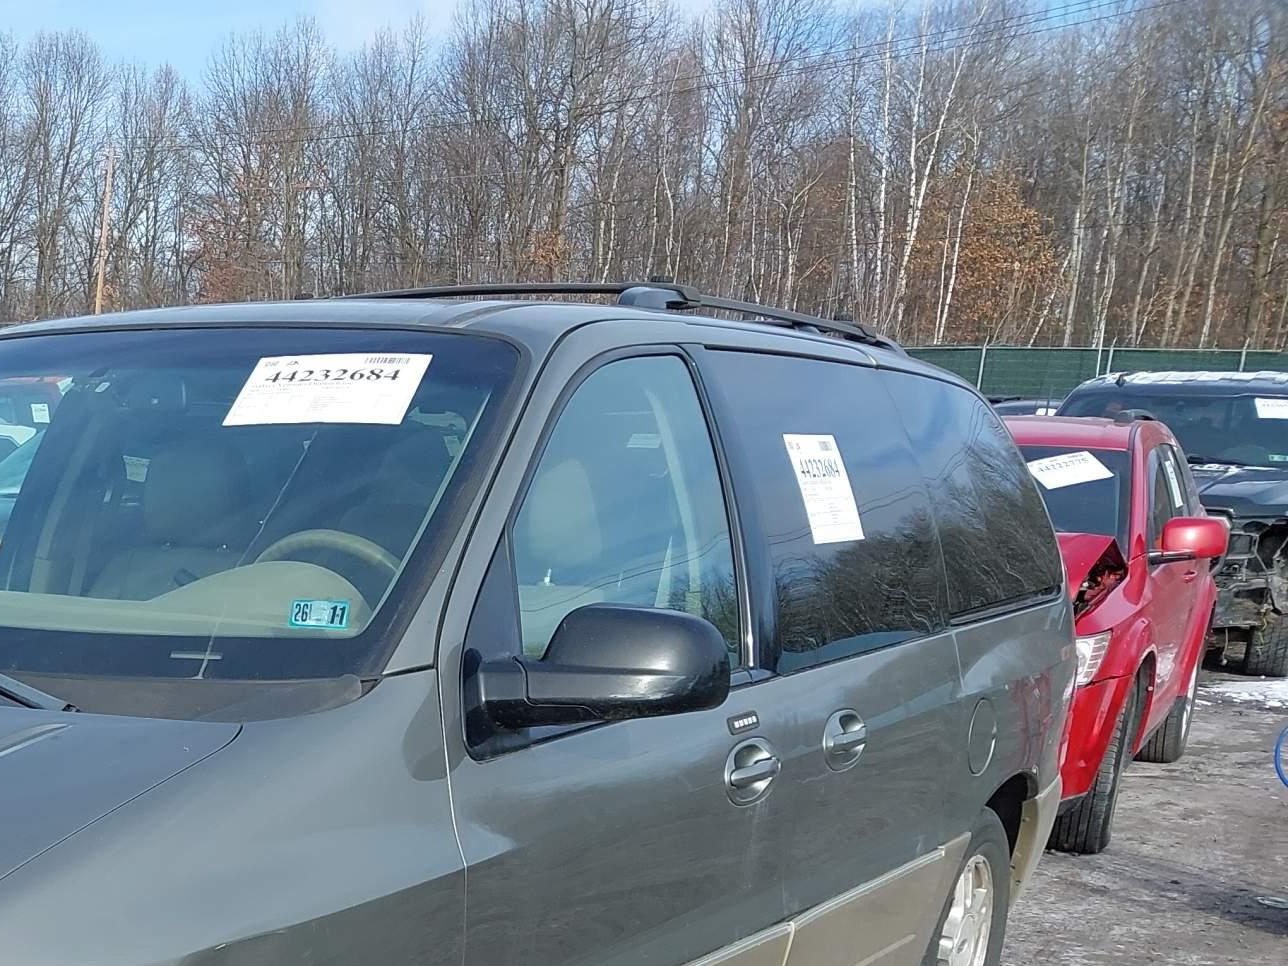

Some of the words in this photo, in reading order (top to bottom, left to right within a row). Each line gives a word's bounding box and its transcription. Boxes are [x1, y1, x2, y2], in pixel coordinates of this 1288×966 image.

[265, 367, 402, 384] 44232684
[800, 458, 841, 478] 44232684
[294, 603, 309, 622] 26
[329, 605, 346, 625] 11
